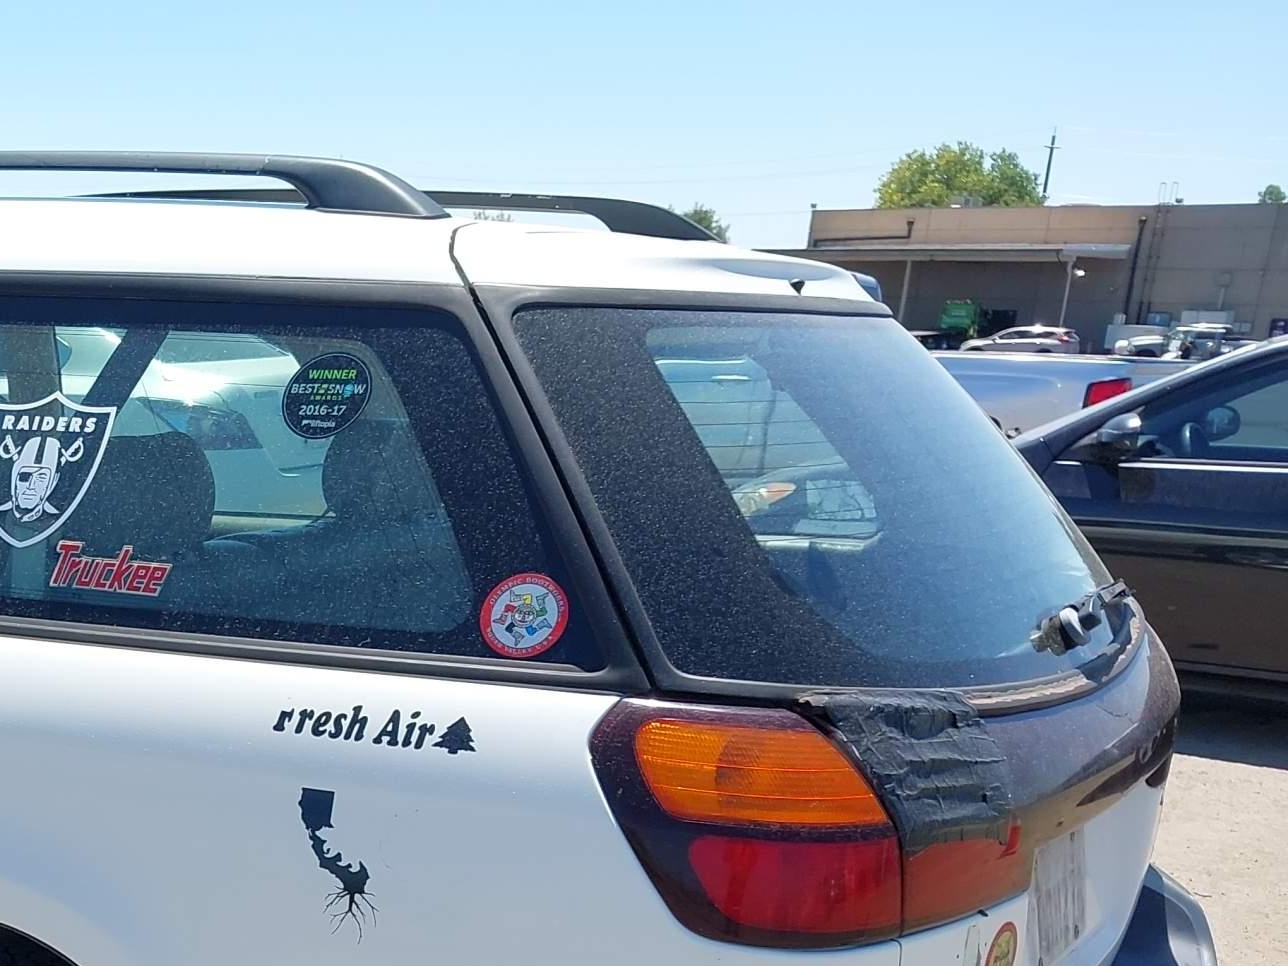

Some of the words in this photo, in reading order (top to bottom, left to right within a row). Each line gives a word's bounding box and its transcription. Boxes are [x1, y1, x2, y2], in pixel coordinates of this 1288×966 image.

[309, 369, 357, 380] WINNER
[291, 383, 320, 394] BEST
[298, 404, 347, 416] 2016-17
[1, 415, 97, 433] RAIDERS
[49, 539, 173, 597] Truckee
[489, 577, 523, 605] OLYMPIC
[372, 709, 436, 750] Air
